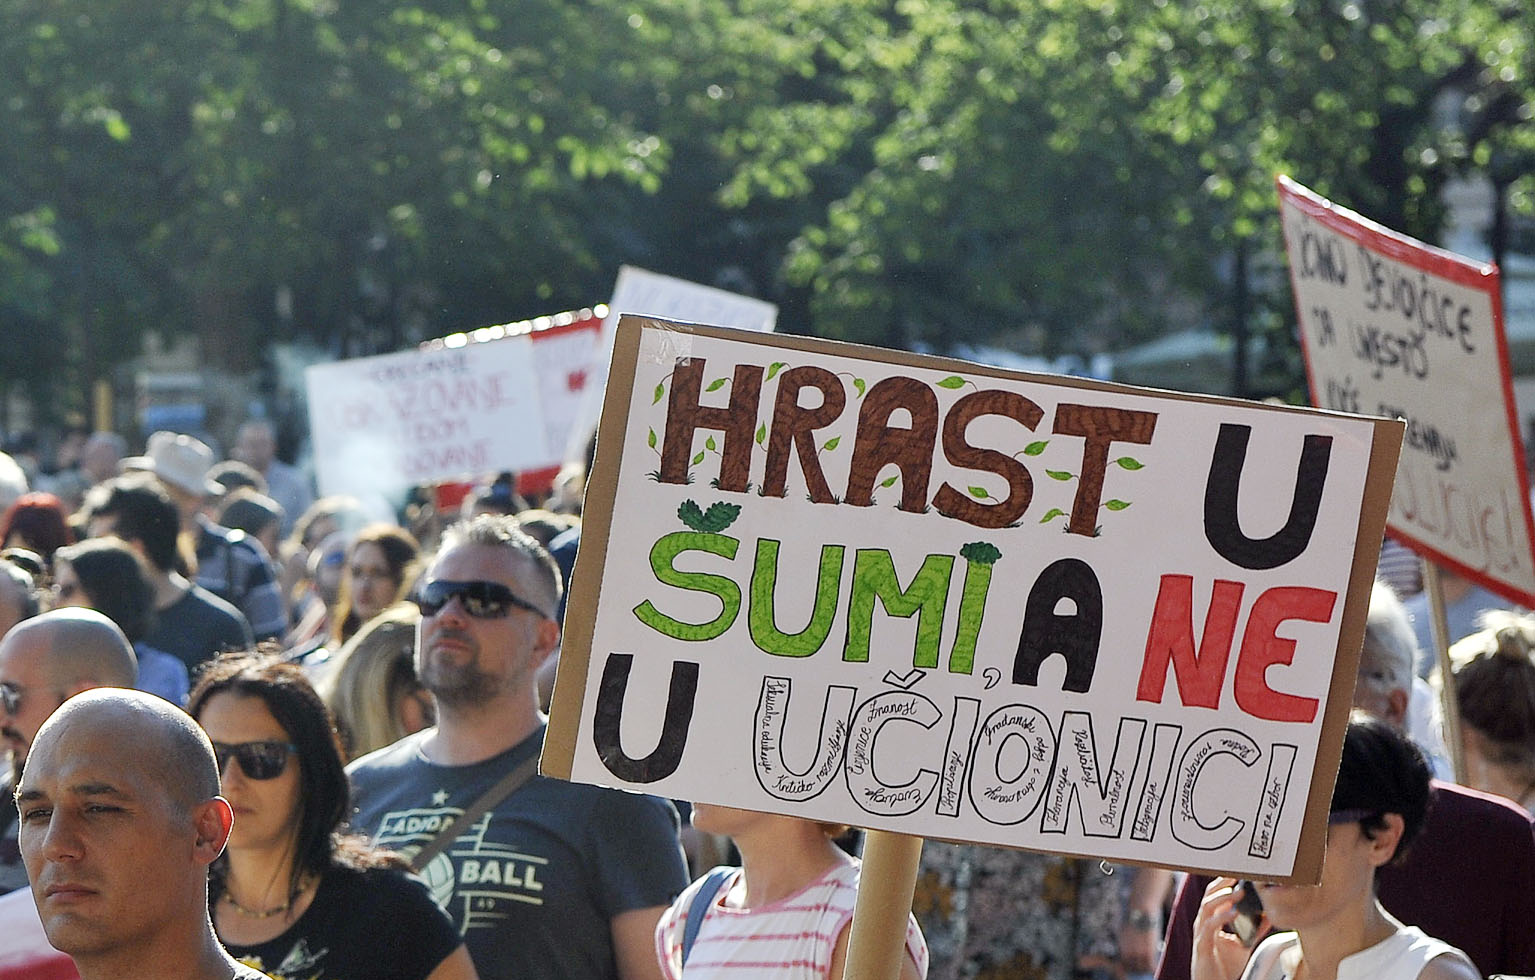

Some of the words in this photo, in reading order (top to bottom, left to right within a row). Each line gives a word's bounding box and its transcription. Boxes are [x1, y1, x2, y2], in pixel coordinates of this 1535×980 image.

[658, 355, 1160, 540] HRAST
[1202, 422, 1334, 570] U
[1013, 557, 1104, 694] A
[1135, 573, 1339, 723] NE
[592, 652, 700, 784] U
[752, 668, 1298, 859] UČIONICI
[459, 859, 544, 892] BALL
